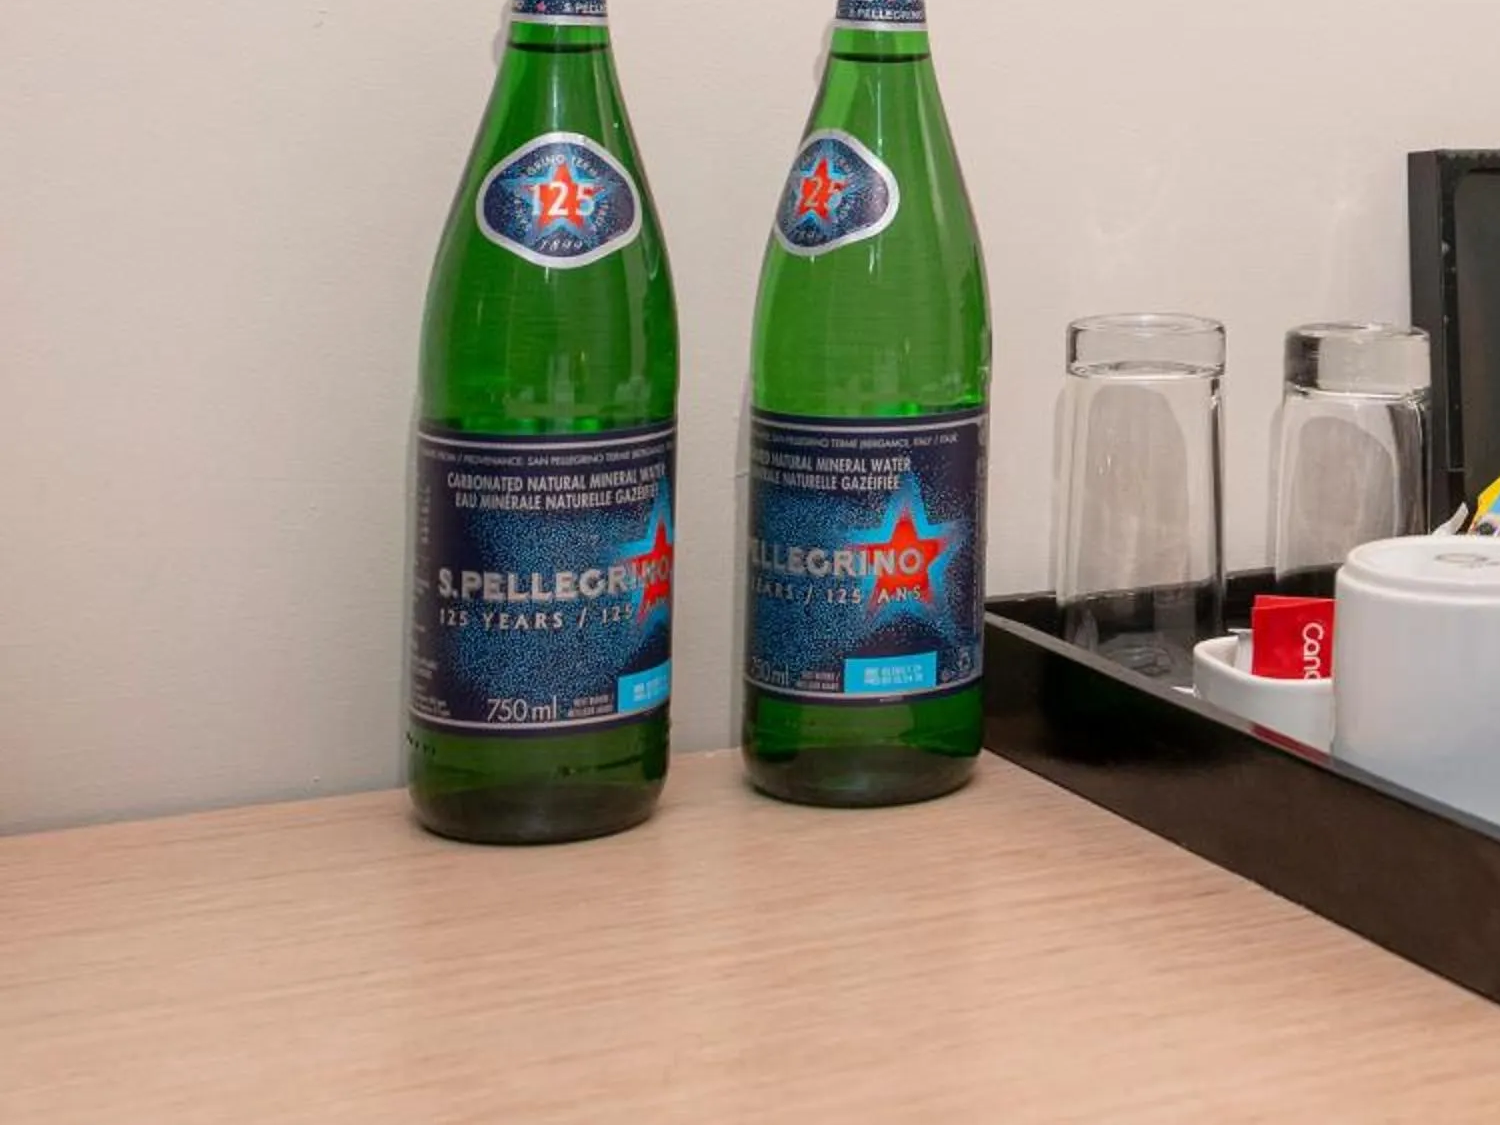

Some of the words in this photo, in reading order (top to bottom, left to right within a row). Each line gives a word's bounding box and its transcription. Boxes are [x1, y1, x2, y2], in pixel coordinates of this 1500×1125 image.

[527, 180, 595, 217] 125
[815, 457, 867, 473] MINERAL
[870, 456, 912, 473] WATER
[447, 471, 523, 492] CARBONATED
[527, 474, 587, 492] NATURAL
[589, 469, 638, 489] MINERAL
[454, 490, 478, 508] EAU
[545, 489, 613, 511] NATURELLE
[826, 587, 861, 605] 125
[877, 584, 923, 605] ANS
[440, 608, 468, 627] 125
[482, 610, 563, 631] YEARS
